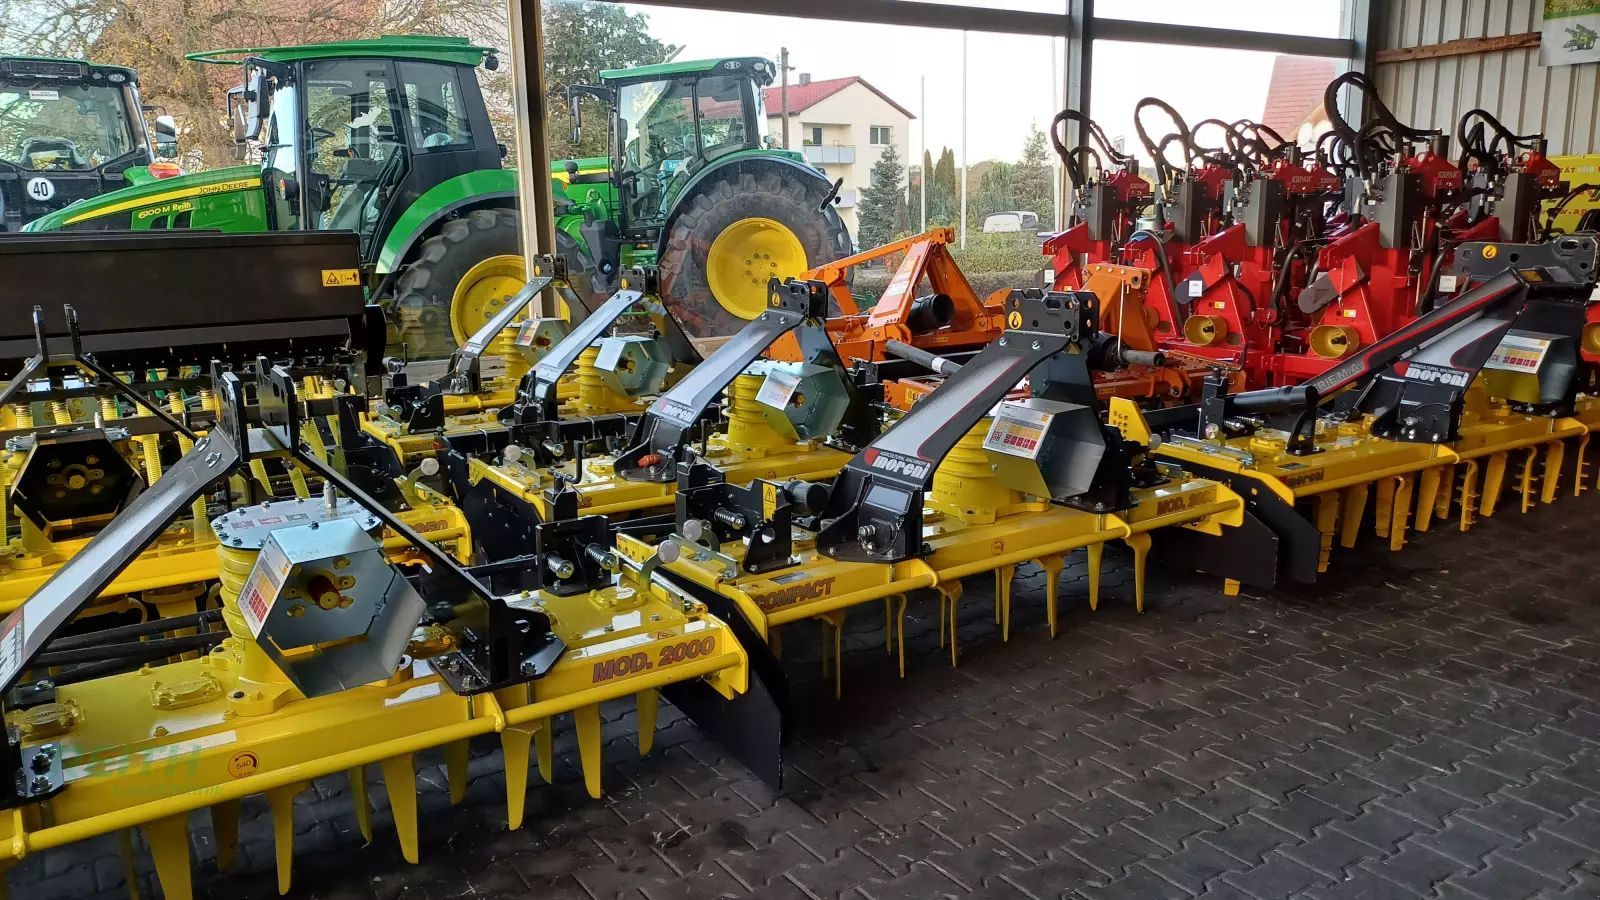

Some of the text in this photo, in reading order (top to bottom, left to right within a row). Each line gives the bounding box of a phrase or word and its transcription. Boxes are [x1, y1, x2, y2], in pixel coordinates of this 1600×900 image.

[1291, 175, 1311, 183] KRPAN
[33, 182, 48, 196] 40
[199, 182, 249, 194] JOHN DEERE
[138, 208, 161, 219] 6100
[1405, 367, 1469, 387] moreni
[662, 403, 697, 422] moreni
[872, 455, 931, 479] moreni
[755, 576, 836, 609] COMPACT
[592, 636, 716, 683] MOD. 2000
[236, 760, 251, 769] 540
